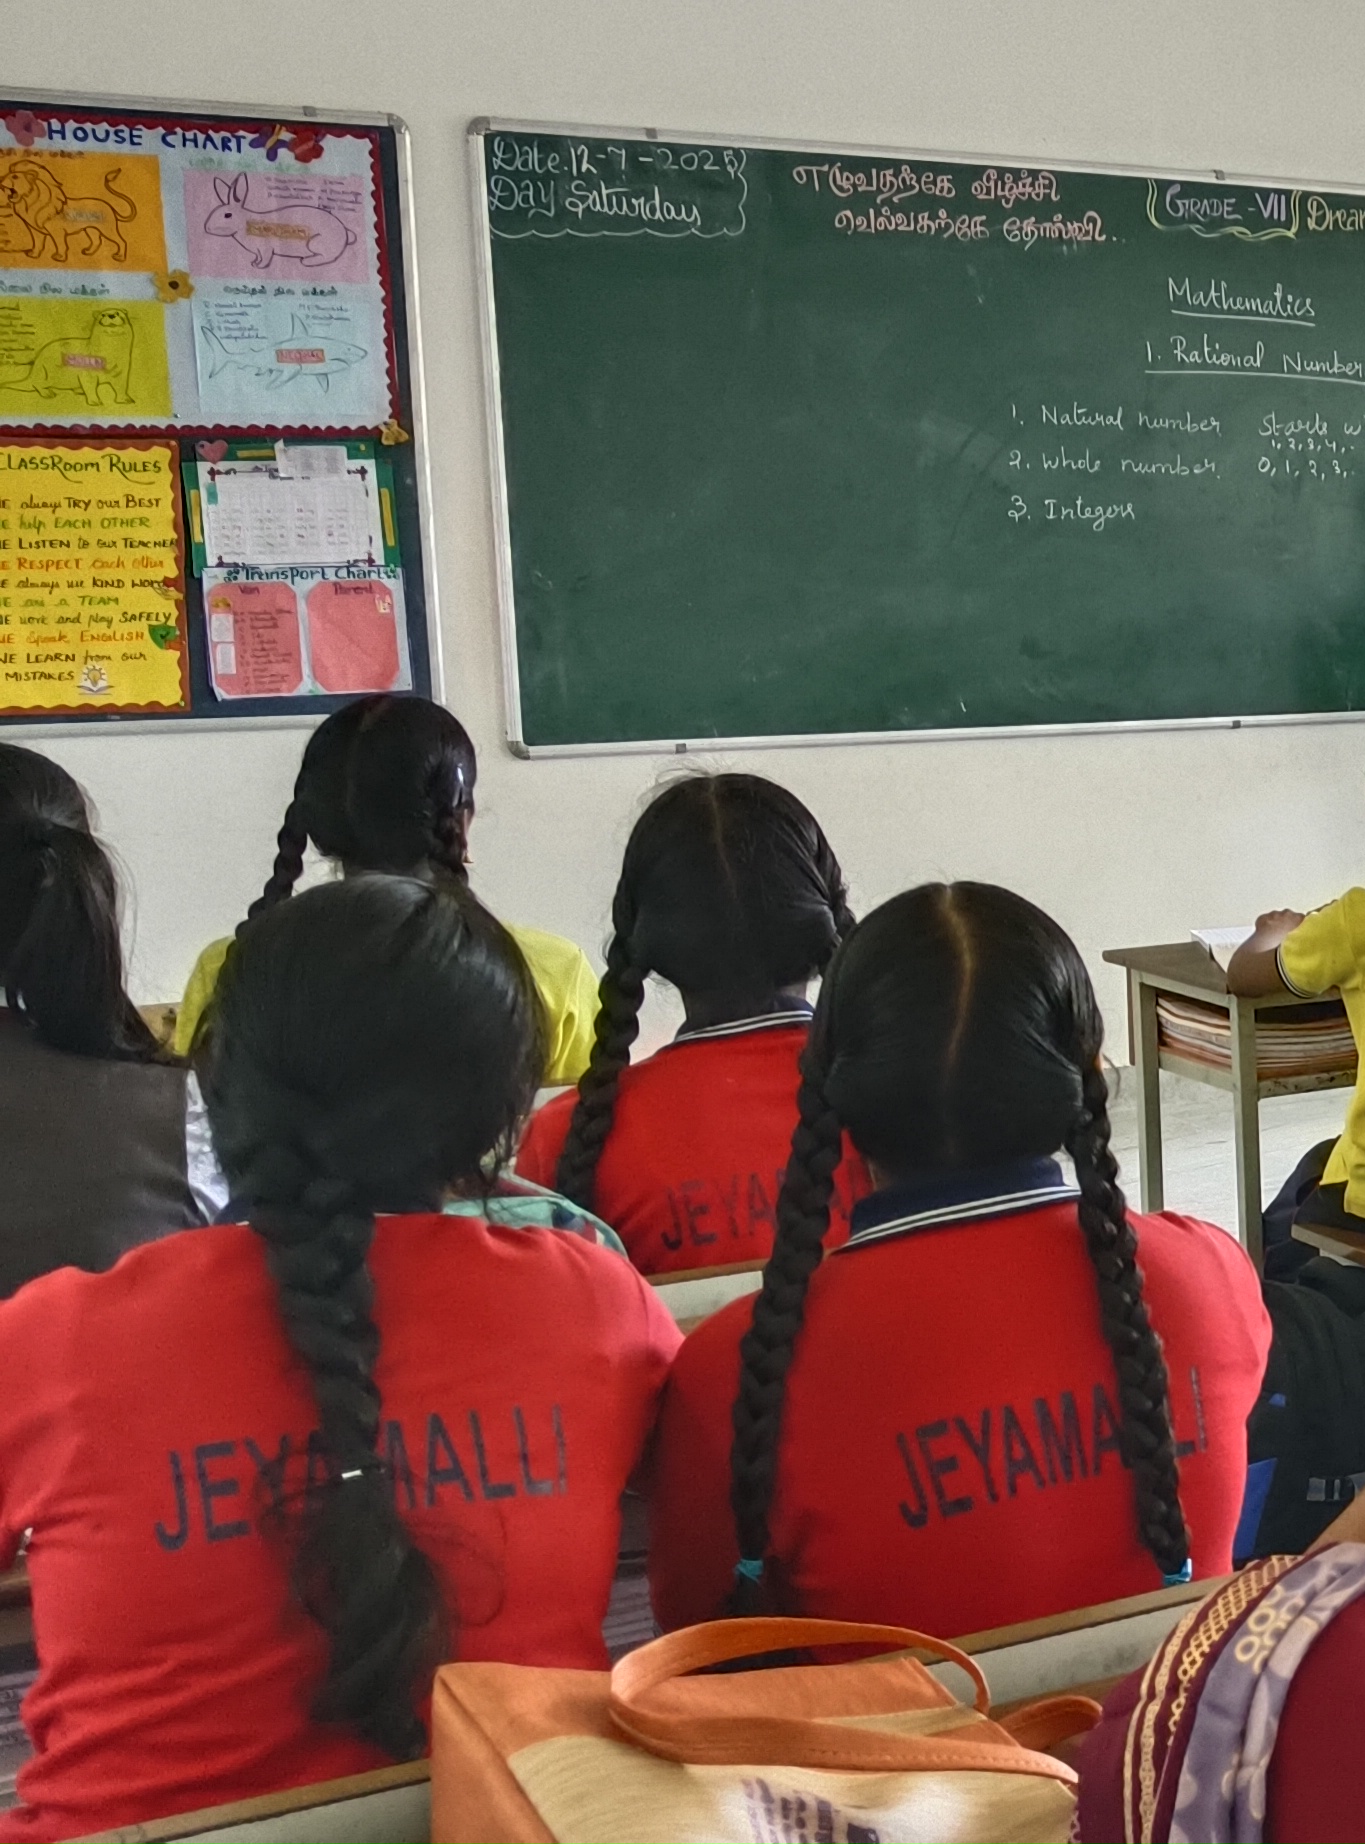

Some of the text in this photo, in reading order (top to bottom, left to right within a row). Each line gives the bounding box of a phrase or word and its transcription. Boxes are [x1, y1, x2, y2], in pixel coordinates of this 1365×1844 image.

[47, 121, 246, 153] HOUSE CHART
[490, 175, 701, 226] Day Saturday
[1166, 184, 1242, 222] GRADE
[1167, 276, 1316, 318] Mathematics
[1146, 340, 1162, 363] 1.
[1169, 334, 1264, 369] Rational
[1041, 401, 1124, 431] Natural
[1258, 410, 1329, 436] Starts
[101, 453, 162, 483] RULES
[63, 497, 92, 511] TRY
[96, 497, 120, 509] our
[123, 494, 162, 509] BEST
[19, 514, 46, 535] help
[54, 517, 92, 530] EACH
[100, 517, 151, 529] OTHER
[16, 556, 83, 572] RESPECT
[92, 576, 125, 589] KIND
[78, 595, 119, 608] TEAM
[54, 611, 82, 624] and
[88, 613, 114, 629] play
[119, 611, 172, 625] SAFELY
[80, 630, 145, 644] ENGLISH
[26, 652, 76, 665] LEARN
[5, 671, 75, 682] MISTAKES
